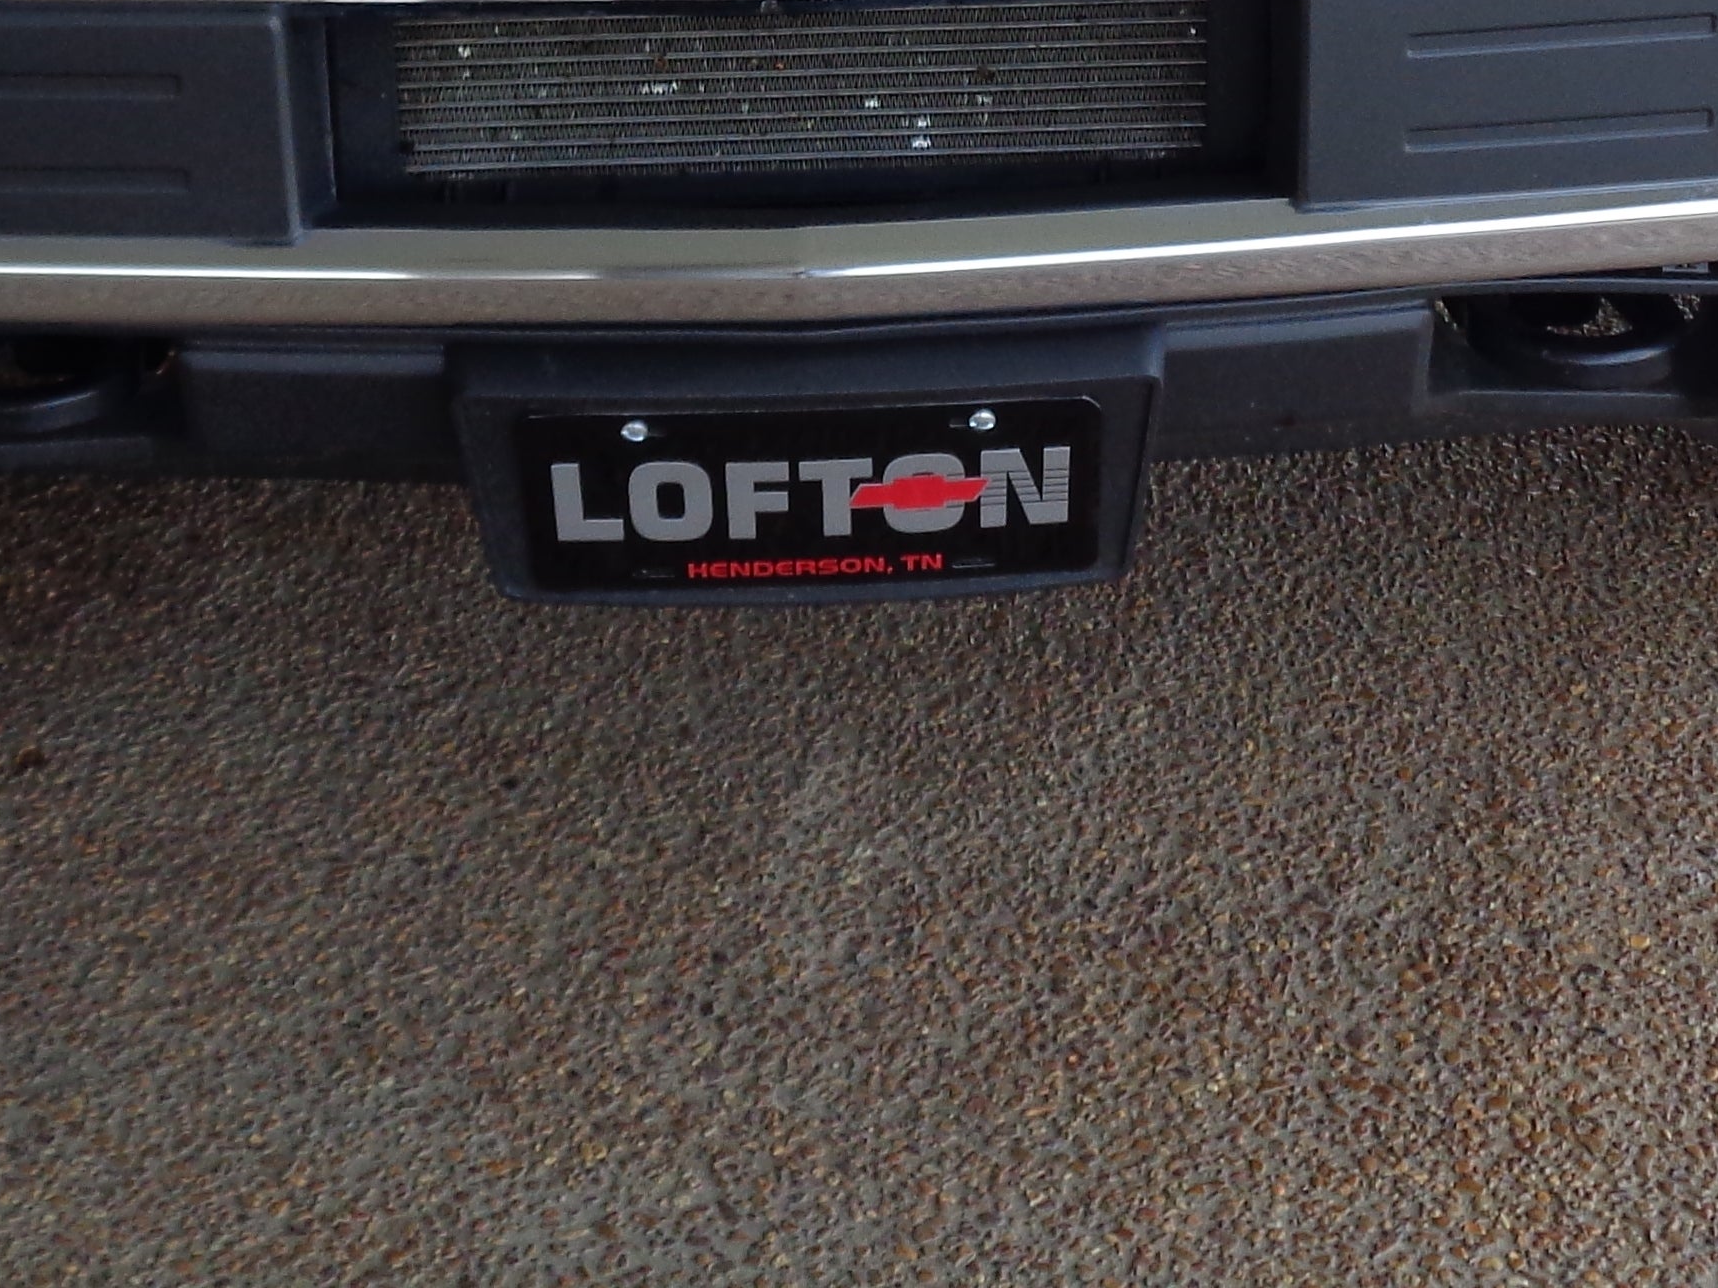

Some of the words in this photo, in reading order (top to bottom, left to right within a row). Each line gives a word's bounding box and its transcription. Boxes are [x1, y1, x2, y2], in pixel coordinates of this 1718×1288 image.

[550, 446, 1071, 542] LOFTON
[687, 556, 895, 579] HENDERSON,
[900, 553, 944, 572] TN
